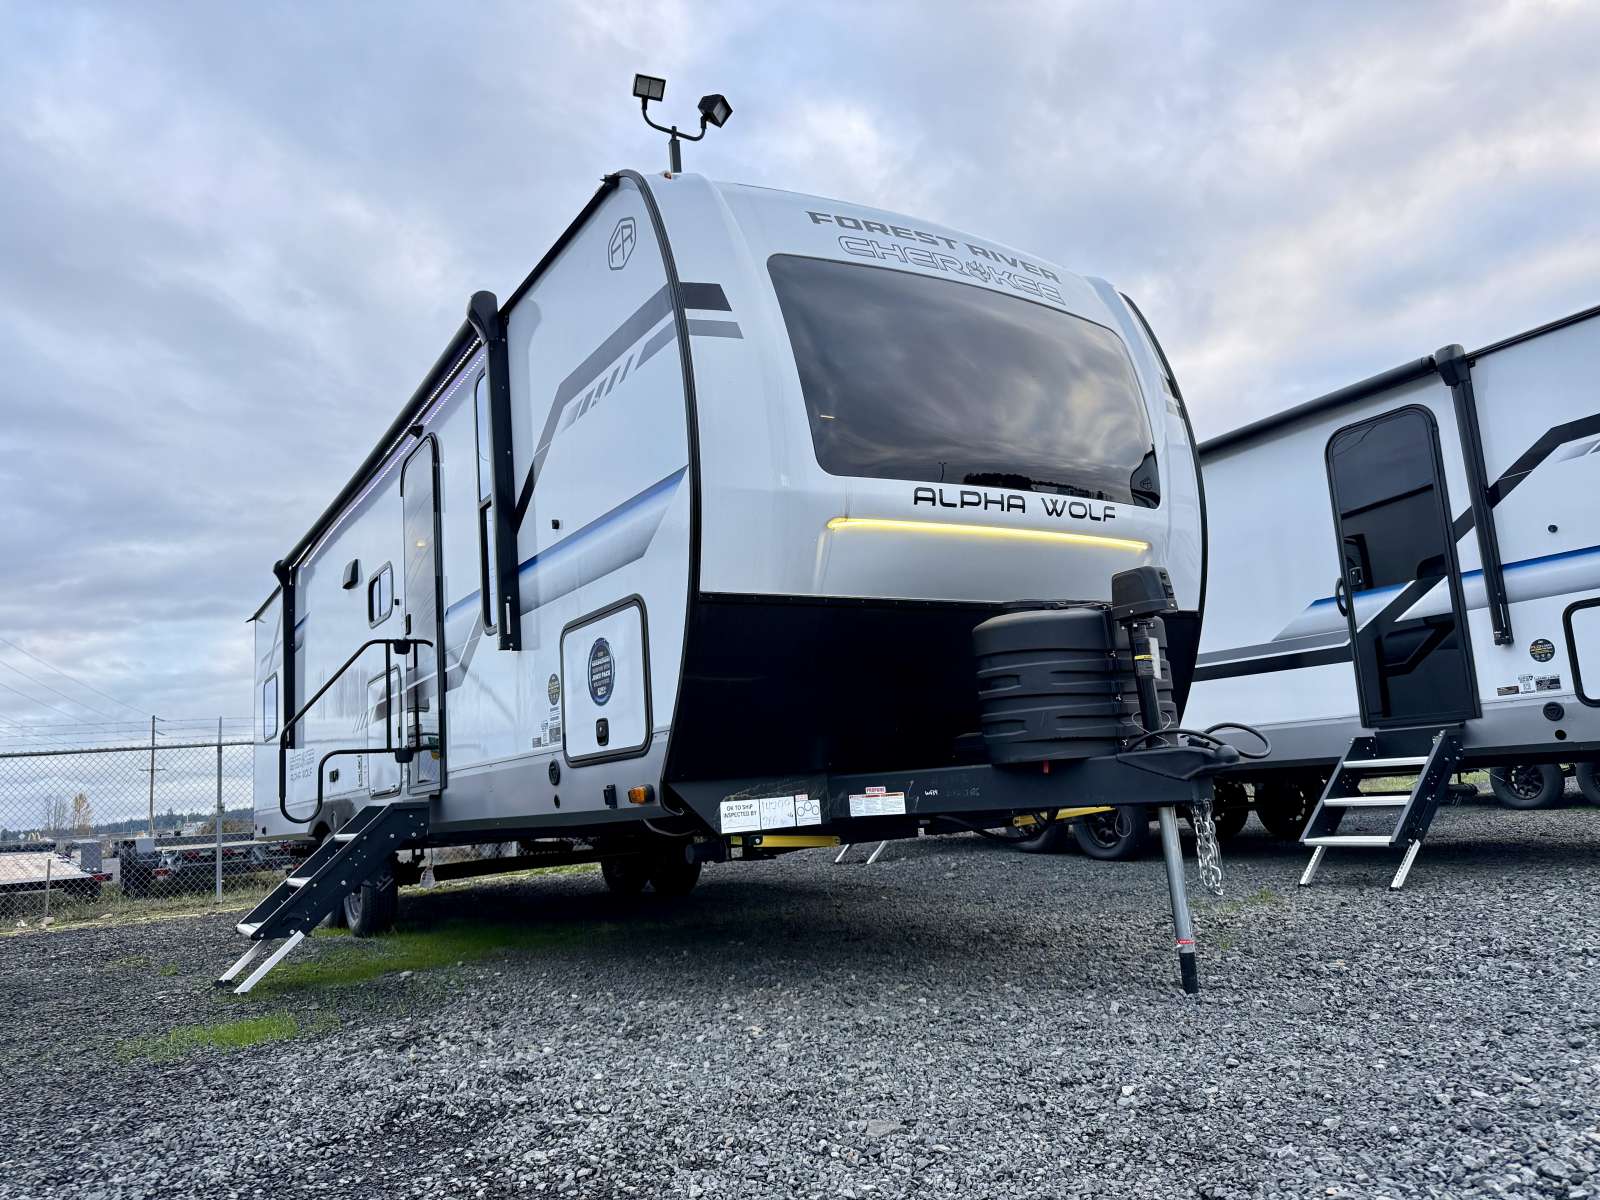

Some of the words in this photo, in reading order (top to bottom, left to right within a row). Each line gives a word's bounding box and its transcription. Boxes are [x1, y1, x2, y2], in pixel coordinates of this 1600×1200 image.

[805, 211, 958, 250] FOREST
[966, 243, 1060, 283] RIVER
[914, 487, 1025, 513] ALPHA
[1041, 497, 1116, 522] WOLF
